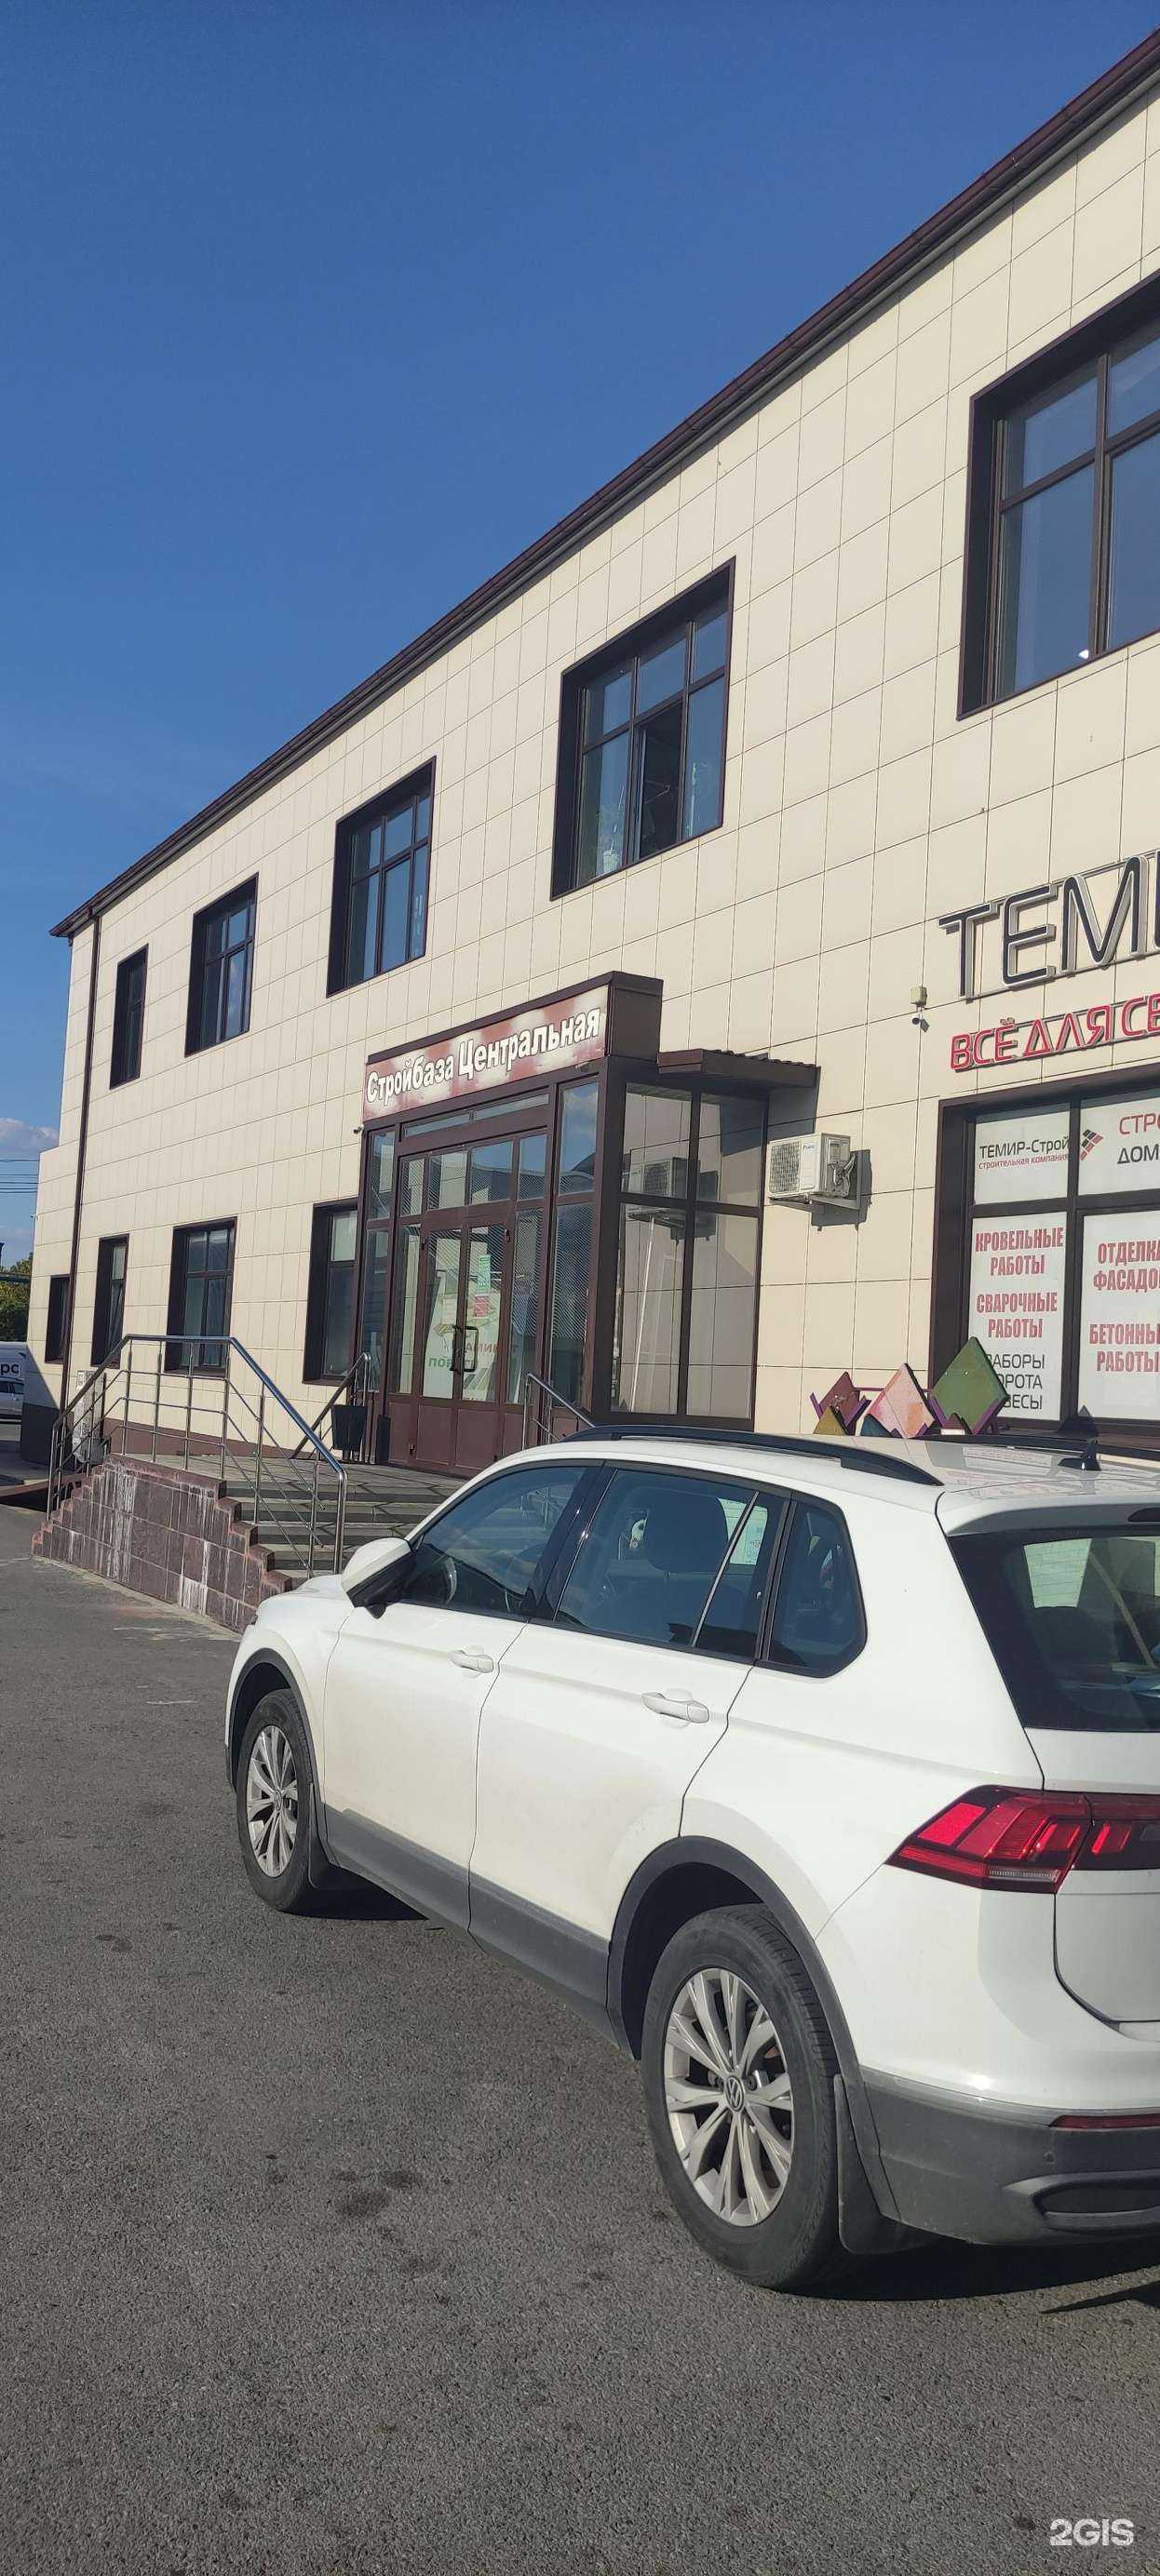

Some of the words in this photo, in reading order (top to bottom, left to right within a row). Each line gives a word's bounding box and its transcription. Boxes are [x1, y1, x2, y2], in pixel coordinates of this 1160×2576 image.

[937, 849, 1160, 1000] ТЕМ
[950, 1017, 1018, 1072] ВСЁ
[1024, 1004, 1116, 1059] ДЛЯ
[366, 1055, 454, 1106] Стройбаза
[458, 1006, 601, 1080] Центральная
[1119, 1113, 1160, 1134] СТР
[979, 1136, 1070, 1159] ТЕМИР-Строй
[1117, 1143, 1159, 1164] ДОМ
[978, 1157, 1029, 1170] строительная
[976, 1228, 1063, 1252] КРОВЕЛЬНЫЕ
[991, 1254, 1045, 1276] РАБОТЫ
[1093, 1268, 1160, 1293] ФАСАДО
[978, 1292, 1058, 1313] СВАРОЧНЫЕ
[989, 1319, 1043, 1337] РАБОТЫ
[1097, 1350, 1159, 1372] РАБОТЫ
